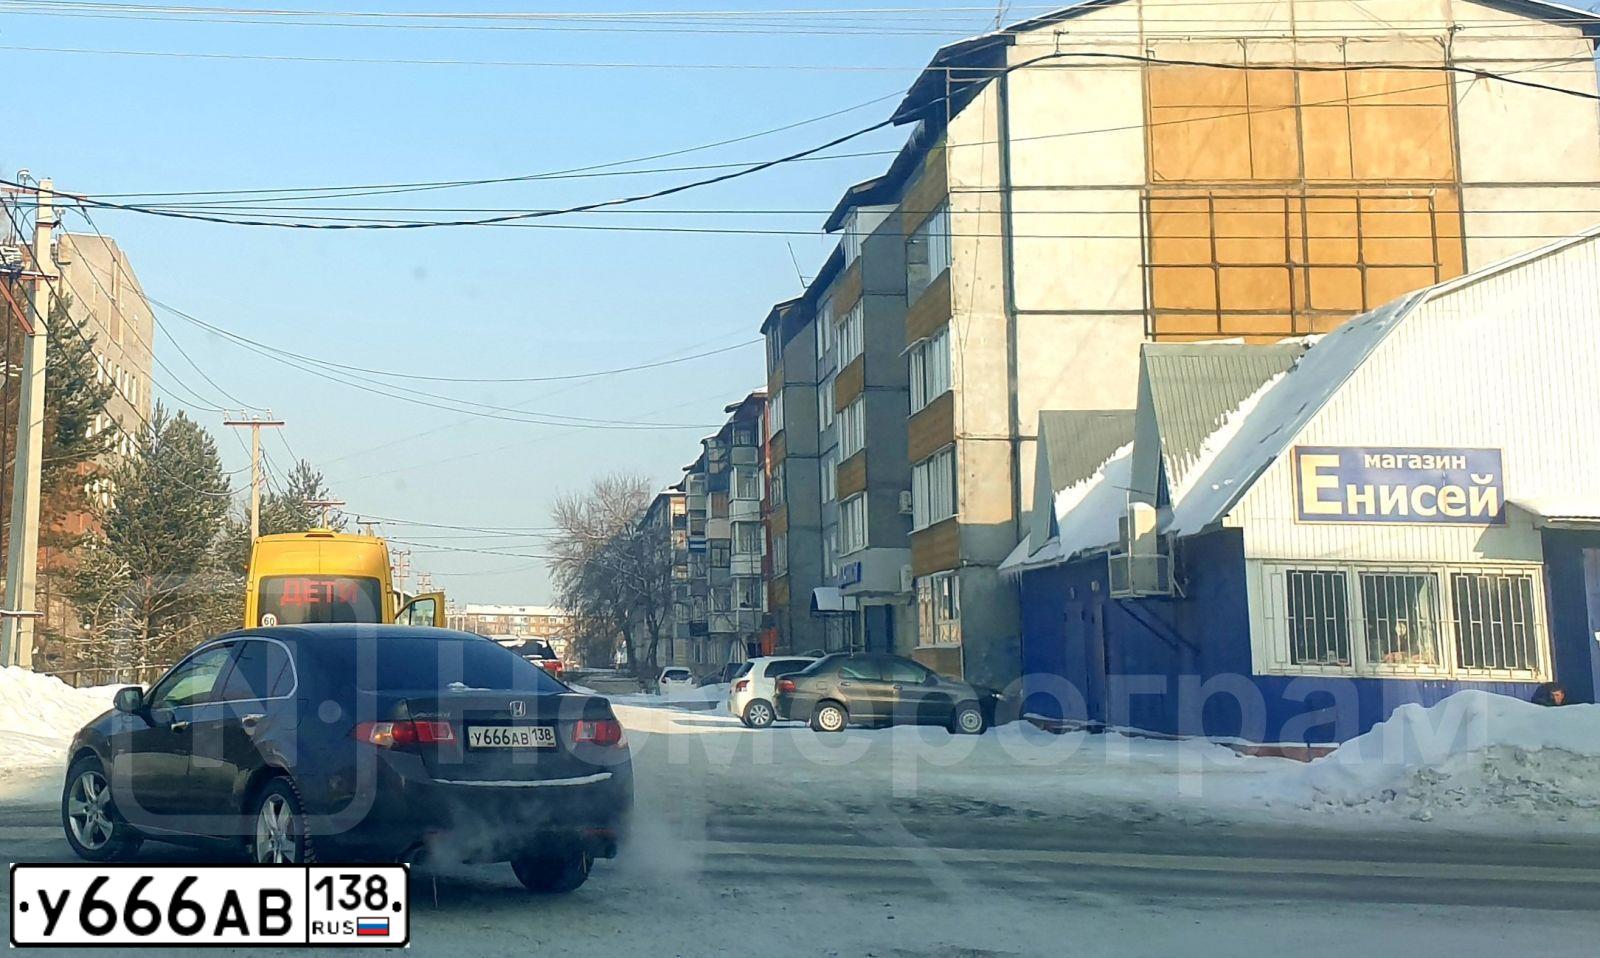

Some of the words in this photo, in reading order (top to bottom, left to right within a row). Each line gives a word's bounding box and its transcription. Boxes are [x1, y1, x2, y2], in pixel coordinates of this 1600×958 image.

[1364, 453, 1466, 469] магазин
[1300, 454, 1498, 517] Енисей
[279, 577, 359, 607] ДЕТИ
[263, 616, 275, 626] 60
[532, 728, 553, 740] 138
